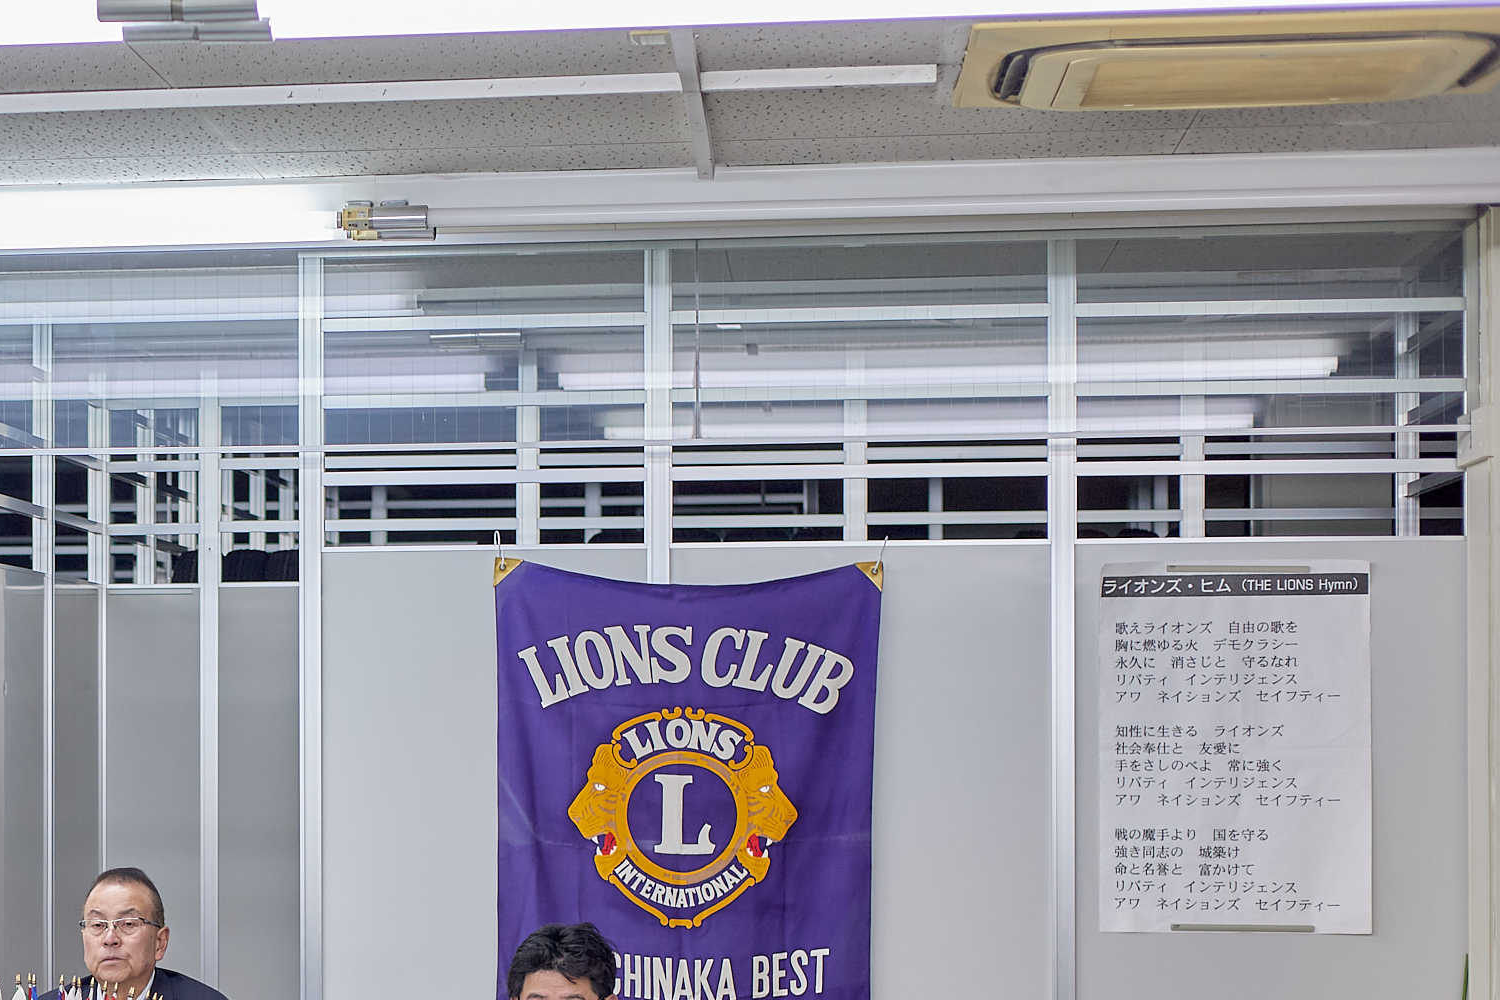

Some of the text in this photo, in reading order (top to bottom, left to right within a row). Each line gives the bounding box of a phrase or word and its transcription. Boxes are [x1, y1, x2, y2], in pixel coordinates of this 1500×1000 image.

[1102, 578, 1232, 594] ライオンズ・ヒム
[1276, 578, 1314, 591] LIONS
[1115, 621, 1298, 635] 歌えライオンズ 自由の歌を
[1114, 638, 1298, 652] 胸に燃ゆる火 デモクラシー
[1114, 655, 1299, 669] 永久に 消さじと 守るなれ
[517, 625, 855, 715] LIONS CLUB
[1117, 673, 1298, 686] リバティ インテリジェンス
[1115, 690, 1341, 703] アワ ネイションズ セイフティー
[1114, 725, 1285, 738] 知性に生きる ライオンズ
[622, 718, 744, 760] LIONS
[1114, 742, 1241, 755] 社会奉仕と 友愛に
[1115, 759, 1282, 772] 手をさしのべよ 常に強く
[1116, 777, 1298, 789] リバティ インテリジェンス
[1115, 794, 1341, 806] アワ ネイションズ セイフティー
[654, 774, 716, 855] L
[1114, 828, 1269, 841] 戦の魔手より 国を守る
[1114, 845, 1241, 859] 強き同志の 城築け
[1114, 862, 1255, 876] 命と名誉と 富かけて
[614, 859, 750, 909] INTERNATIONAL
[1116, 880, 1297, 893] リバティ インテリジェンス
[1114, 898, 1340, 911] アワ ネイションズ セイフティー
[752, 948, 830, 999] BEST
